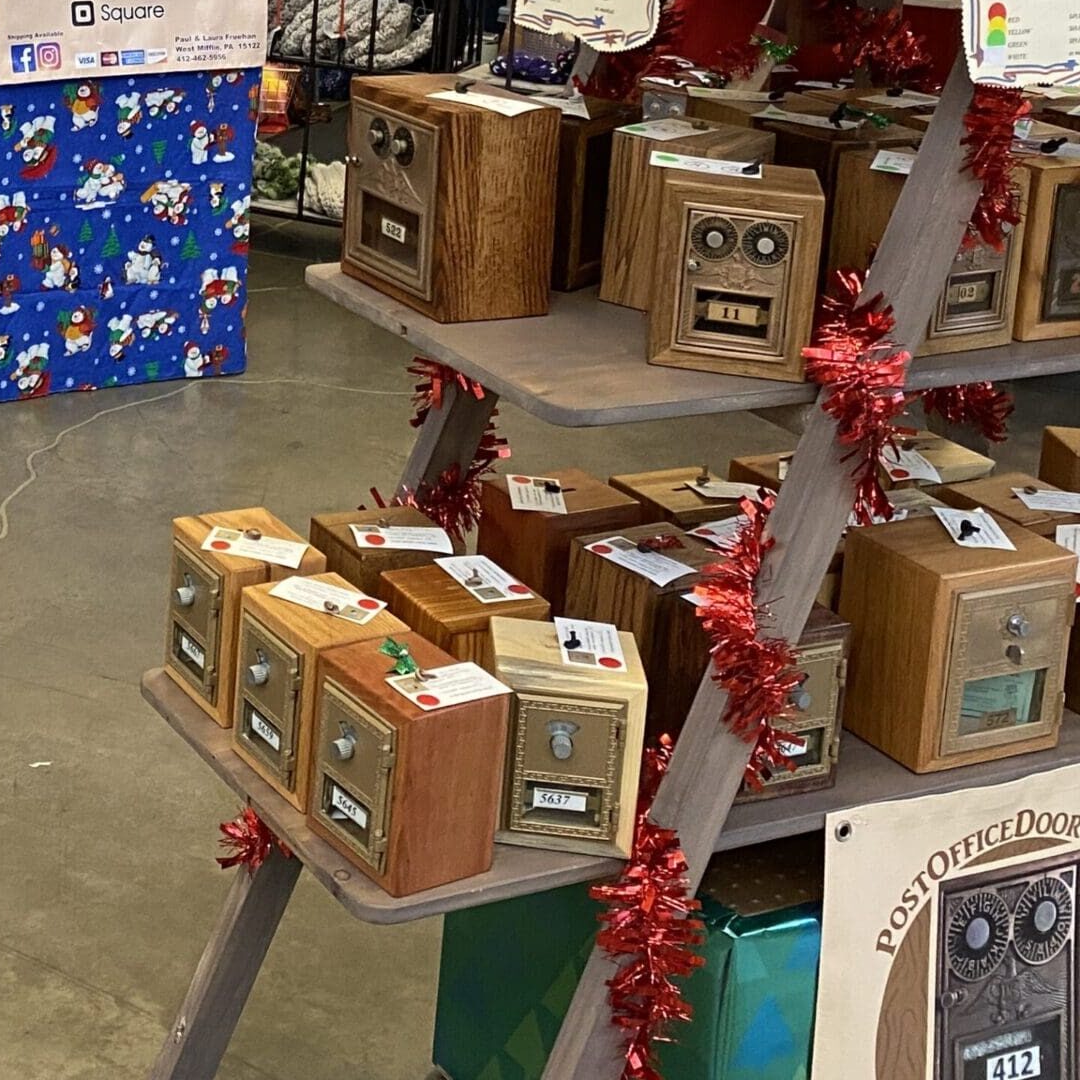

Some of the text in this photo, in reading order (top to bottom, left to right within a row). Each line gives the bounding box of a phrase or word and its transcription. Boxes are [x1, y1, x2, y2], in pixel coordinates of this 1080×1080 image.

[101, 4, 165, 24] Square
[385, 223, 402, 239] 522
[722, 307, 740, 320] 11
[986, 713, 1009, 726] 572
[336, 795, 358, 817] 5645
[538, 793, 571, 807] 5637
[992, 1051, 1034, 1080] 412
